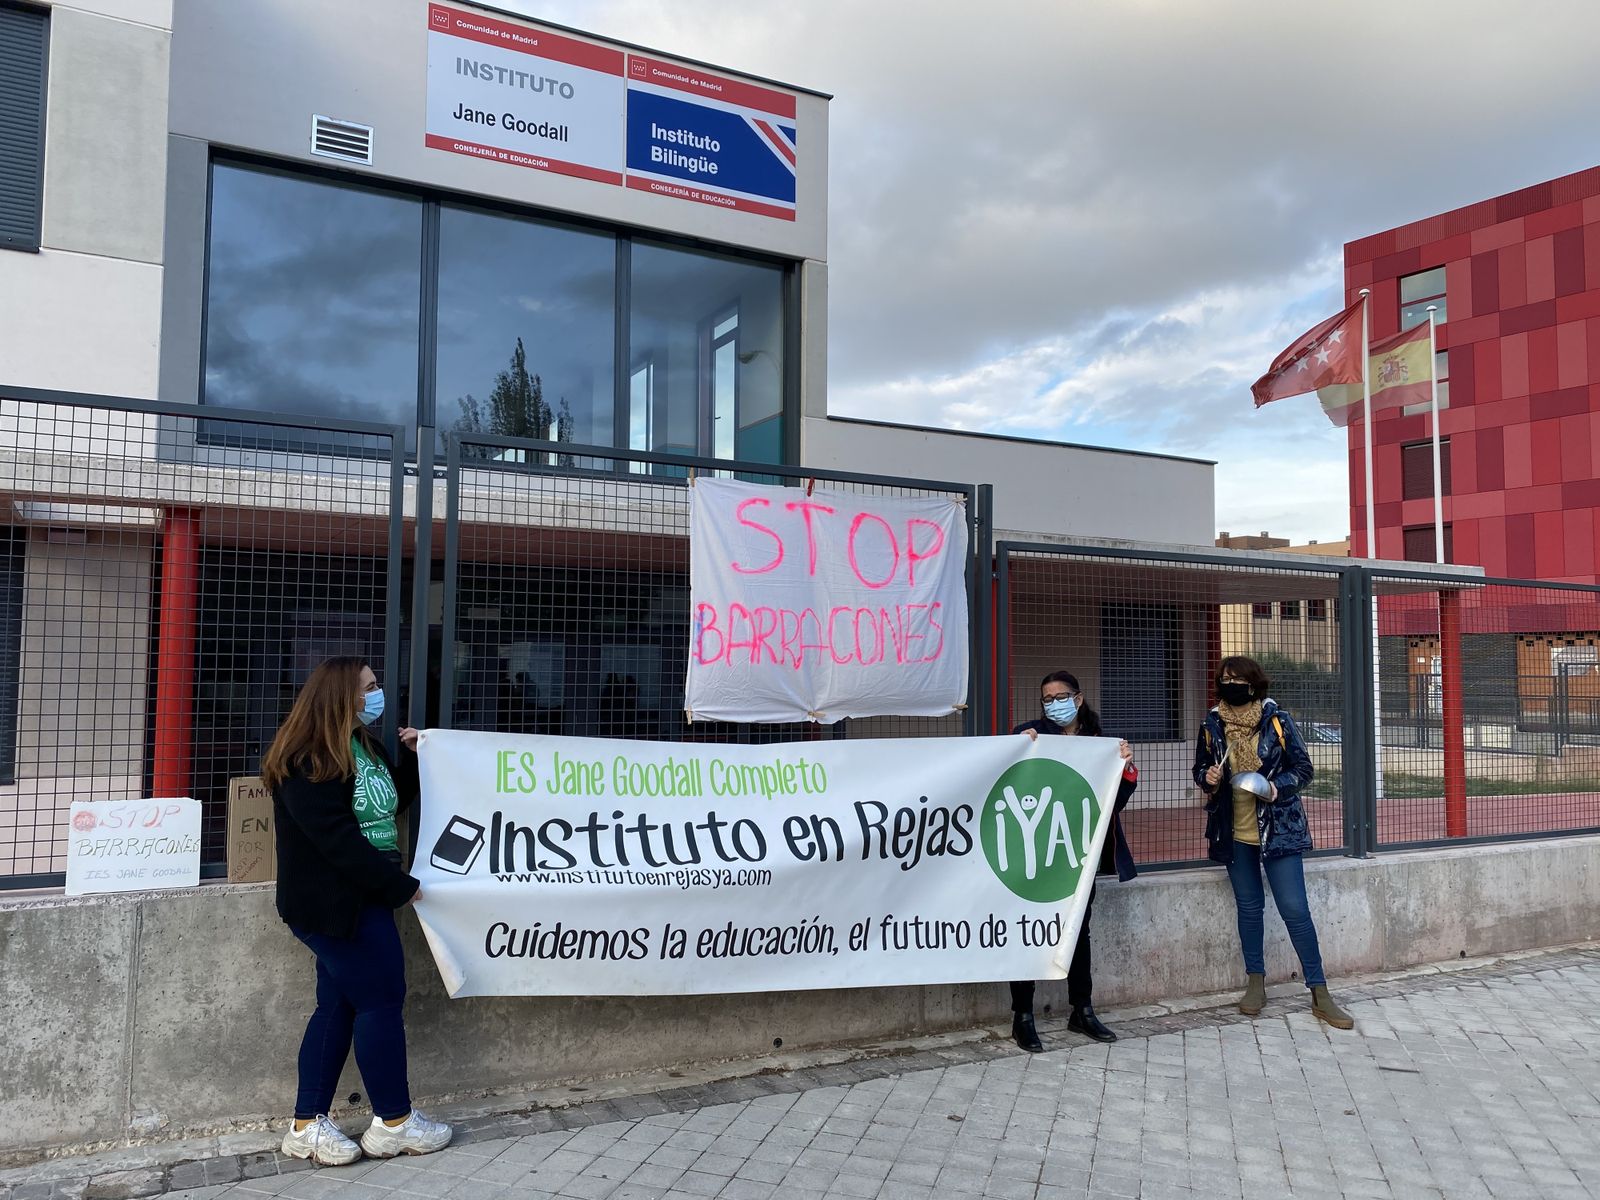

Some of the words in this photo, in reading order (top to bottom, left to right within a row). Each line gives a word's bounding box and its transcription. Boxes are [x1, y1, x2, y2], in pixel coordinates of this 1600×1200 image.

[456, 19, 499, 37] Comunidad
[501, 29, 511, 39] de
[512, 33, 538, 46] Madrid
[456, 57, 575, 99] INSTITUTO
[652, 68, 689, 83] Comunidad
[690, 77, 699, 86] de
[700, 80, 722, 92] Madrid
[453, 103, 496, 127] Jane
[502, 113, 568, 142] Goodall
[651, 122, 721, 153] Instituto
[454, 143, 497, 158] CONSEJERÍA
[498, 152, 508, 160] DE
[510, 154, 549, 168] EDUCACIÓN
[651, 145, 718, 175] Bilingüe
[651, 183, 690, 197] CONSEJERÍA
[691, 191, 700, 199] DE
[702, 193, 736, 207] EDUCACIÓN
[731, 497, 945, 589] STOP
[692, 602, 944, 672] BARRACONES
[496, 750, 537, 795] IES
[546, 751, 605, 796] Jane
[612, 756, 703, 798] Goodall
[709, 757, 828, 801] Completo
[98, 804, 181, 829] STOP
[241, 817, 269, 834] EN
[75, 834, 200, 859] BARRACONES
[489, 809, 767, 875] Instituto
[782, 814, 845, 863] en
[853, 795, 975, 871] Rejas
[994, 785, 1091, 880] ¡YA!
[236, 840, 265, 854] POR
[85, 869, 110, 880] IES
[116, 868, 148, 879] JANE
[152, 867, 192, 879] GOODALL
[496, 867, 772, 890] www.institutoenrejasya.com
[485, 921, 651, 961] Cuidemos
[660, 923, 688, 961] la
[695, 915, 839, 957] educación,
[848, 917, 872, 952] el
[880, 913, 971, 951] futuro
[979, 913, 1008, 948] de
[1016, 912, 1066, 947] tod
